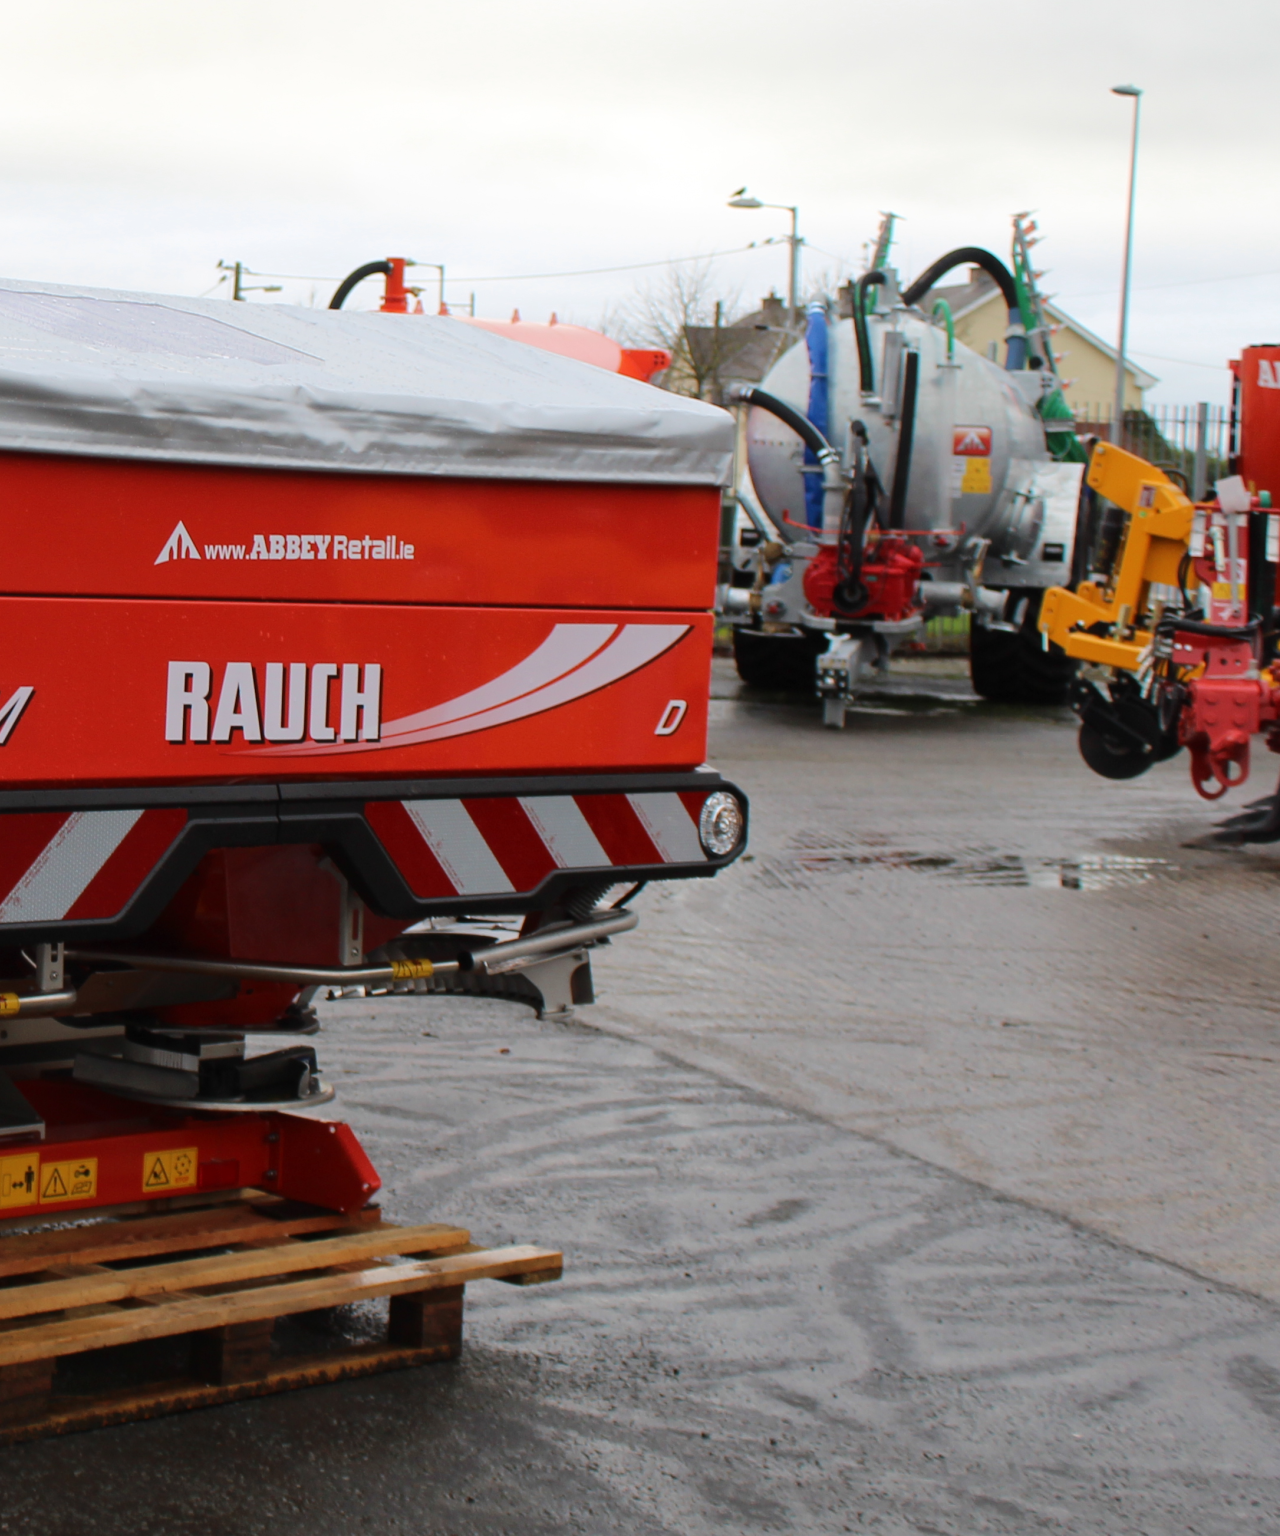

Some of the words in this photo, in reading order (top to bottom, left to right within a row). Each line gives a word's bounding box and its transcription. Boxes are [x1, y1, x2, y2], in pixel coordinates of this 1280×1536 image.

[1257, 359, 1280, 390] A
[204, 534, 415, 560] www.ABBEYRetail.ie
[165, 660, 383, 744] RAUCH
[654, 699, 688, 736] D
